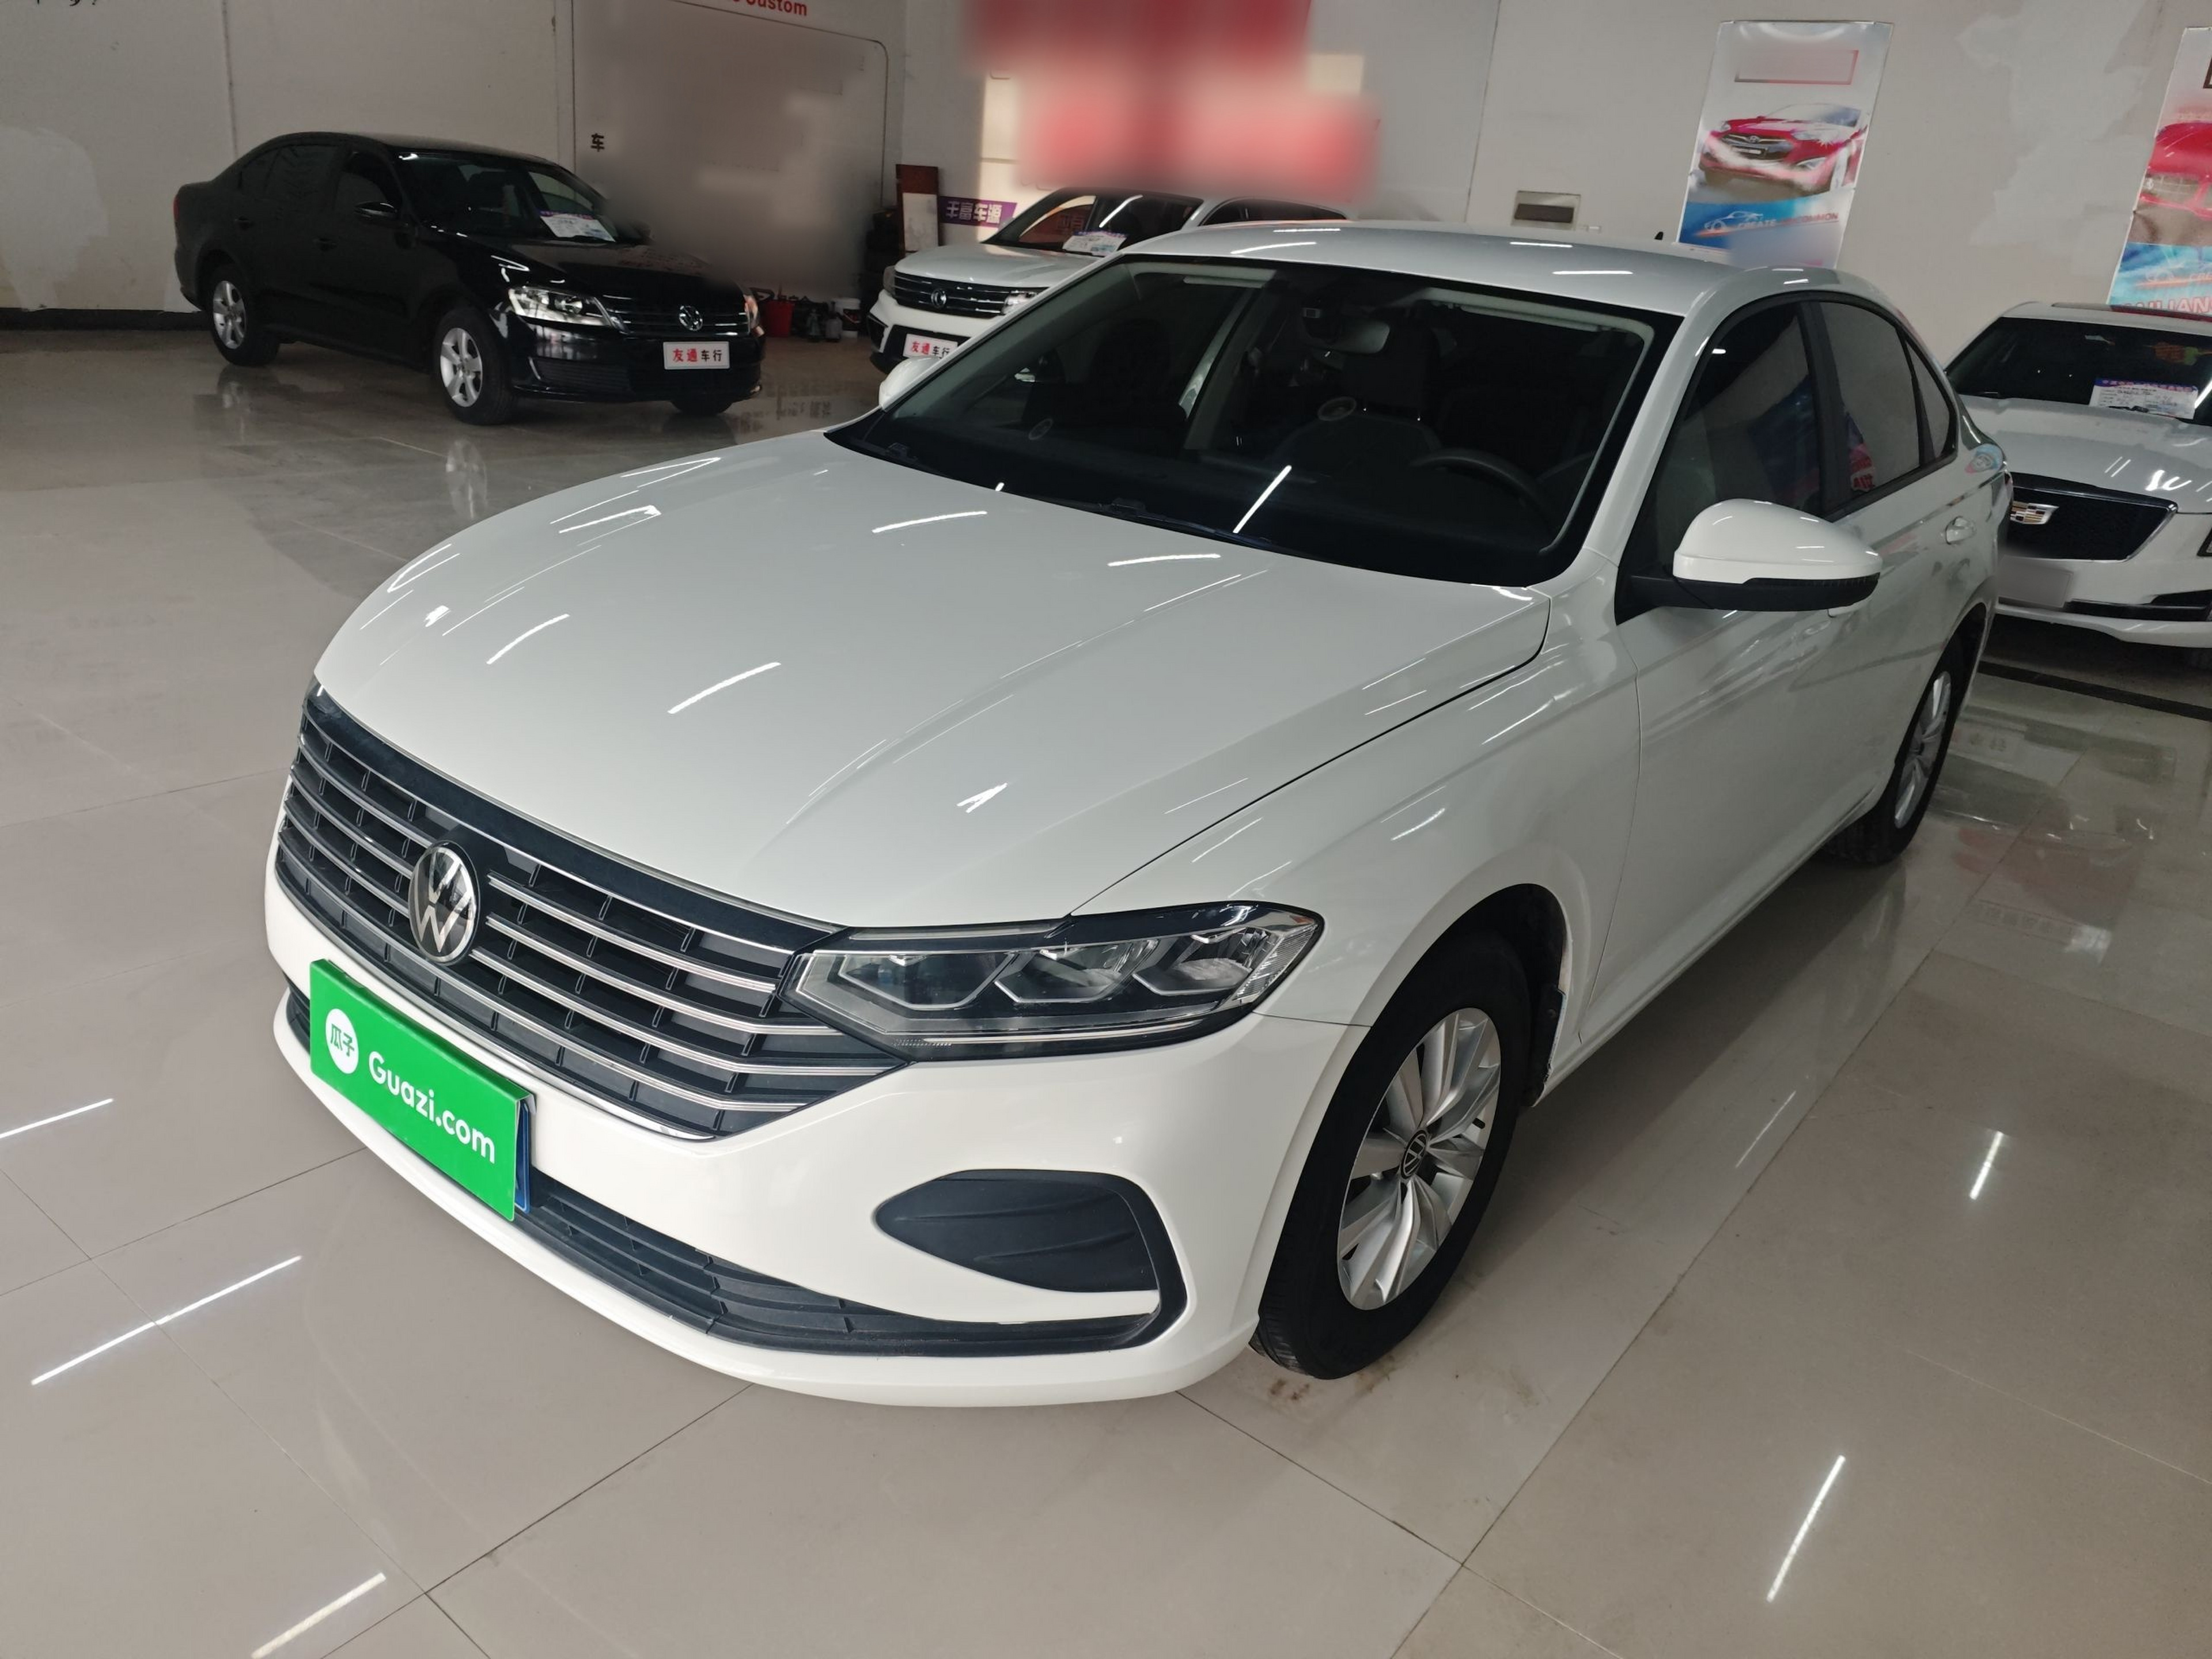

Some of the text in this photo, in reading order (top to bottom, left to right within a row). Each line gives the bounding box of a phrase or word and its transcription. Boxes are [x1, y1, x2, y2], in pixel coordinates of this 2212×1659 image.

[590, 133, 604, 152] 车
[672, 349, 722, 362] 友通车行
[330, 1023, 355, 1057] 瓜子
[369, 1051, 495, 1164] Guazi.com
